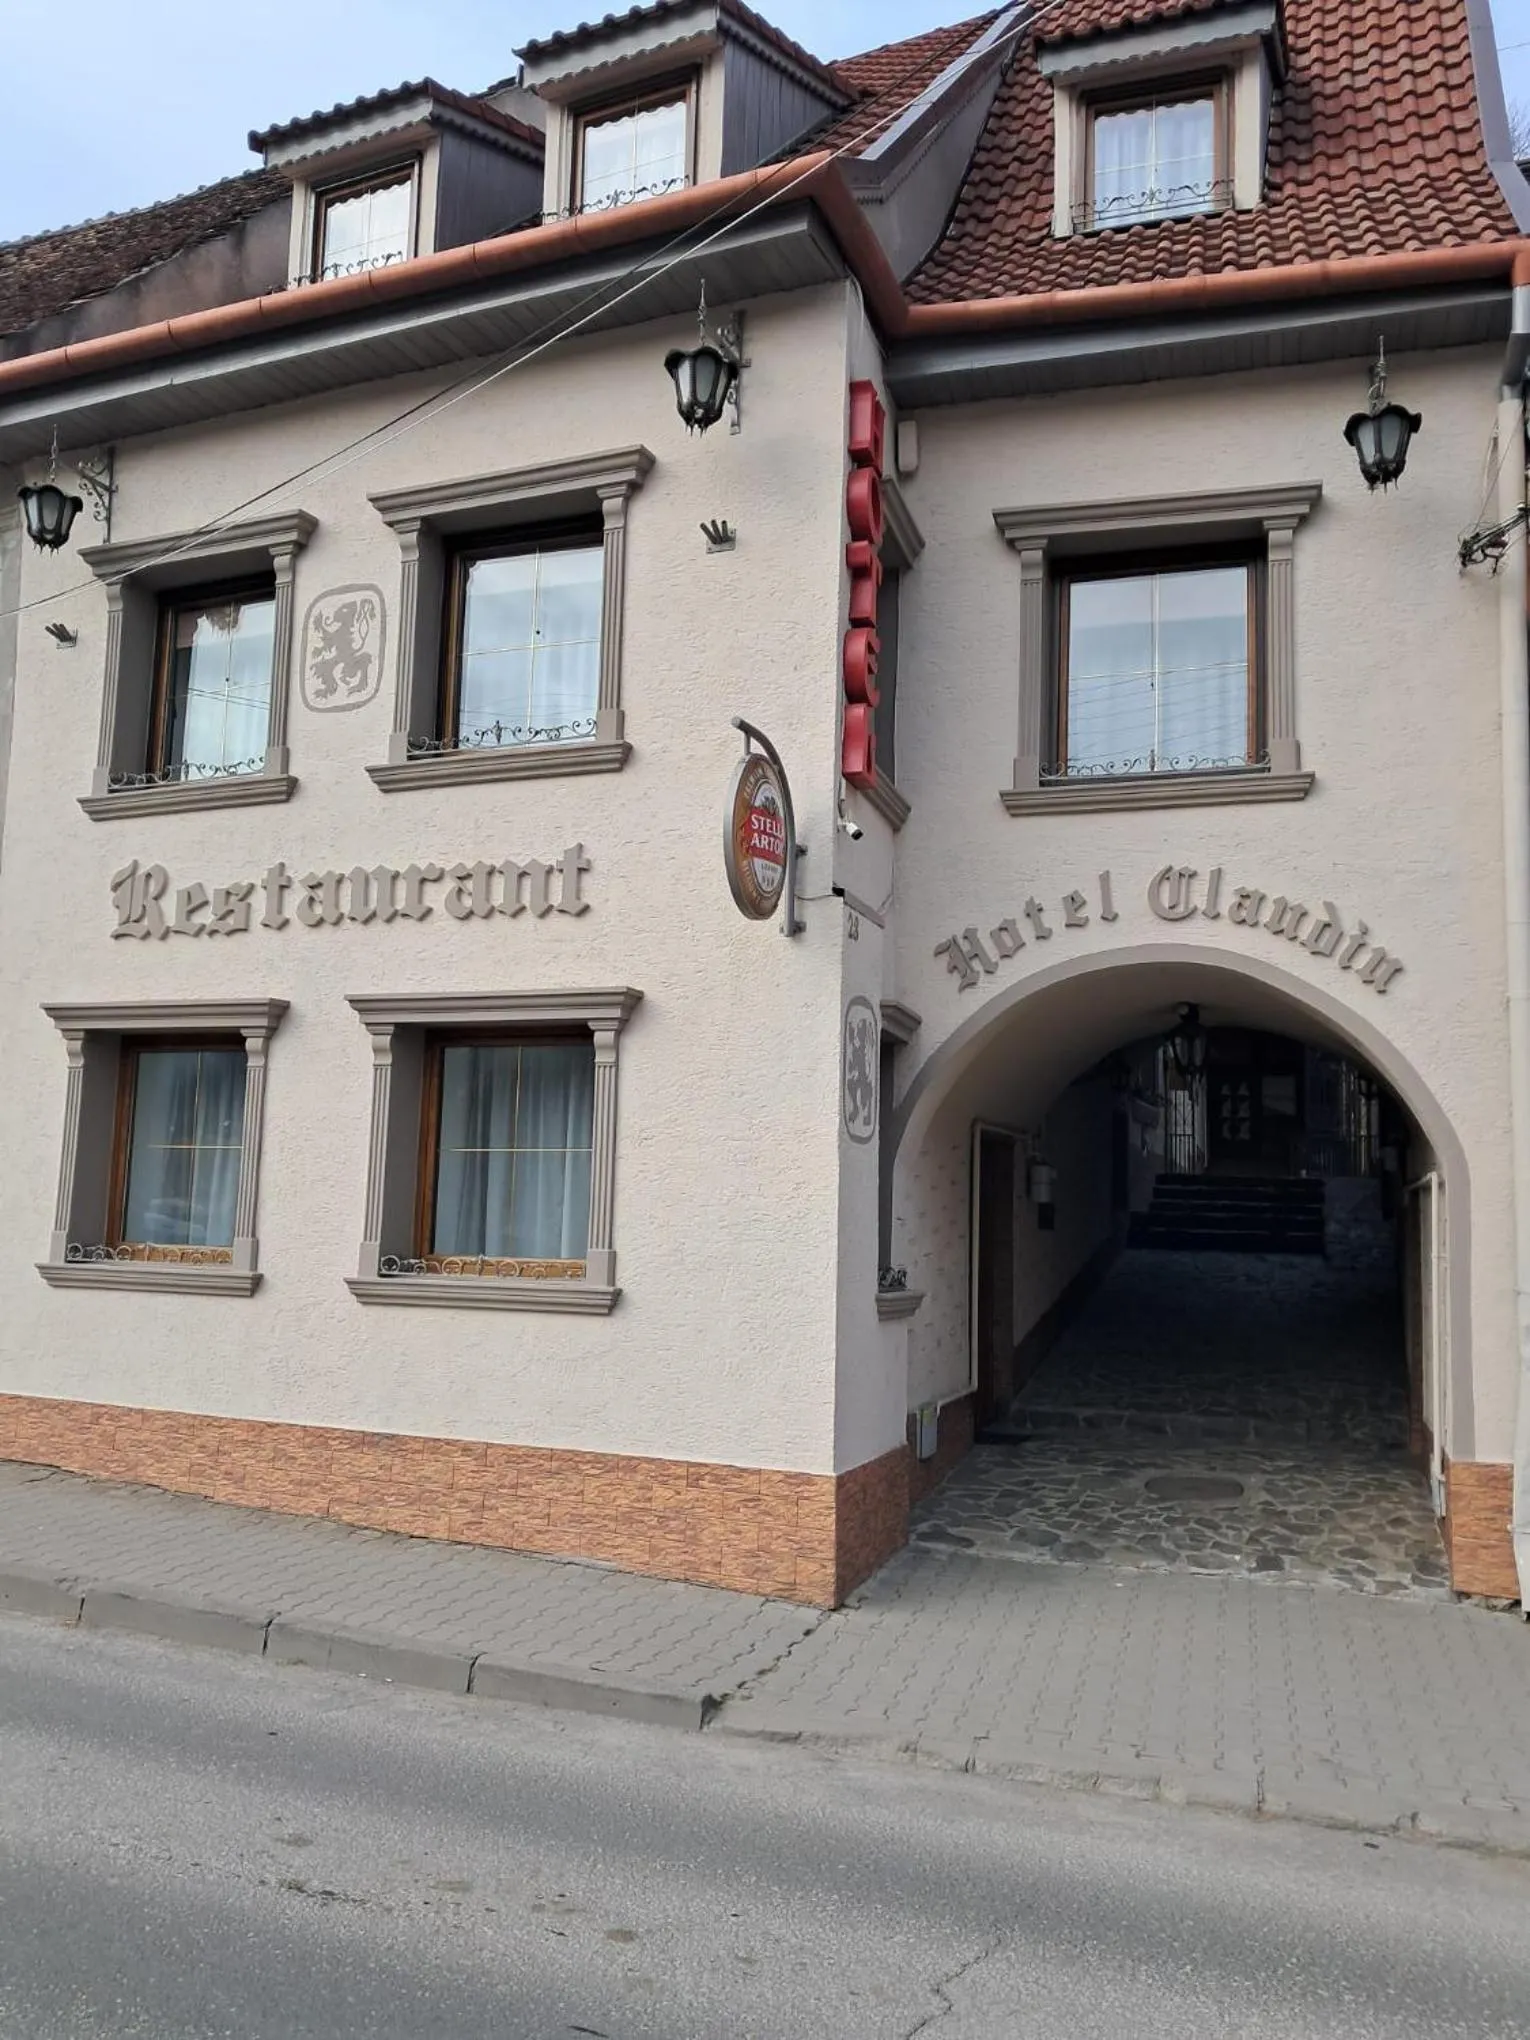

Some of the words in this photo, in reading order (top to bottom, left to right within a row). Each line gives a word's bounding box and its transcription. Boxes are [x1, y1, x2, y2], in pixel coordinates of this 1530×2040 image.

[110, 842, 592, 942] Restaurant
[751, 832, 784, 857] ARTO
[934, 869, 1119, 994] Hotel
[1147, 865, 1404, 995] Claudiu
